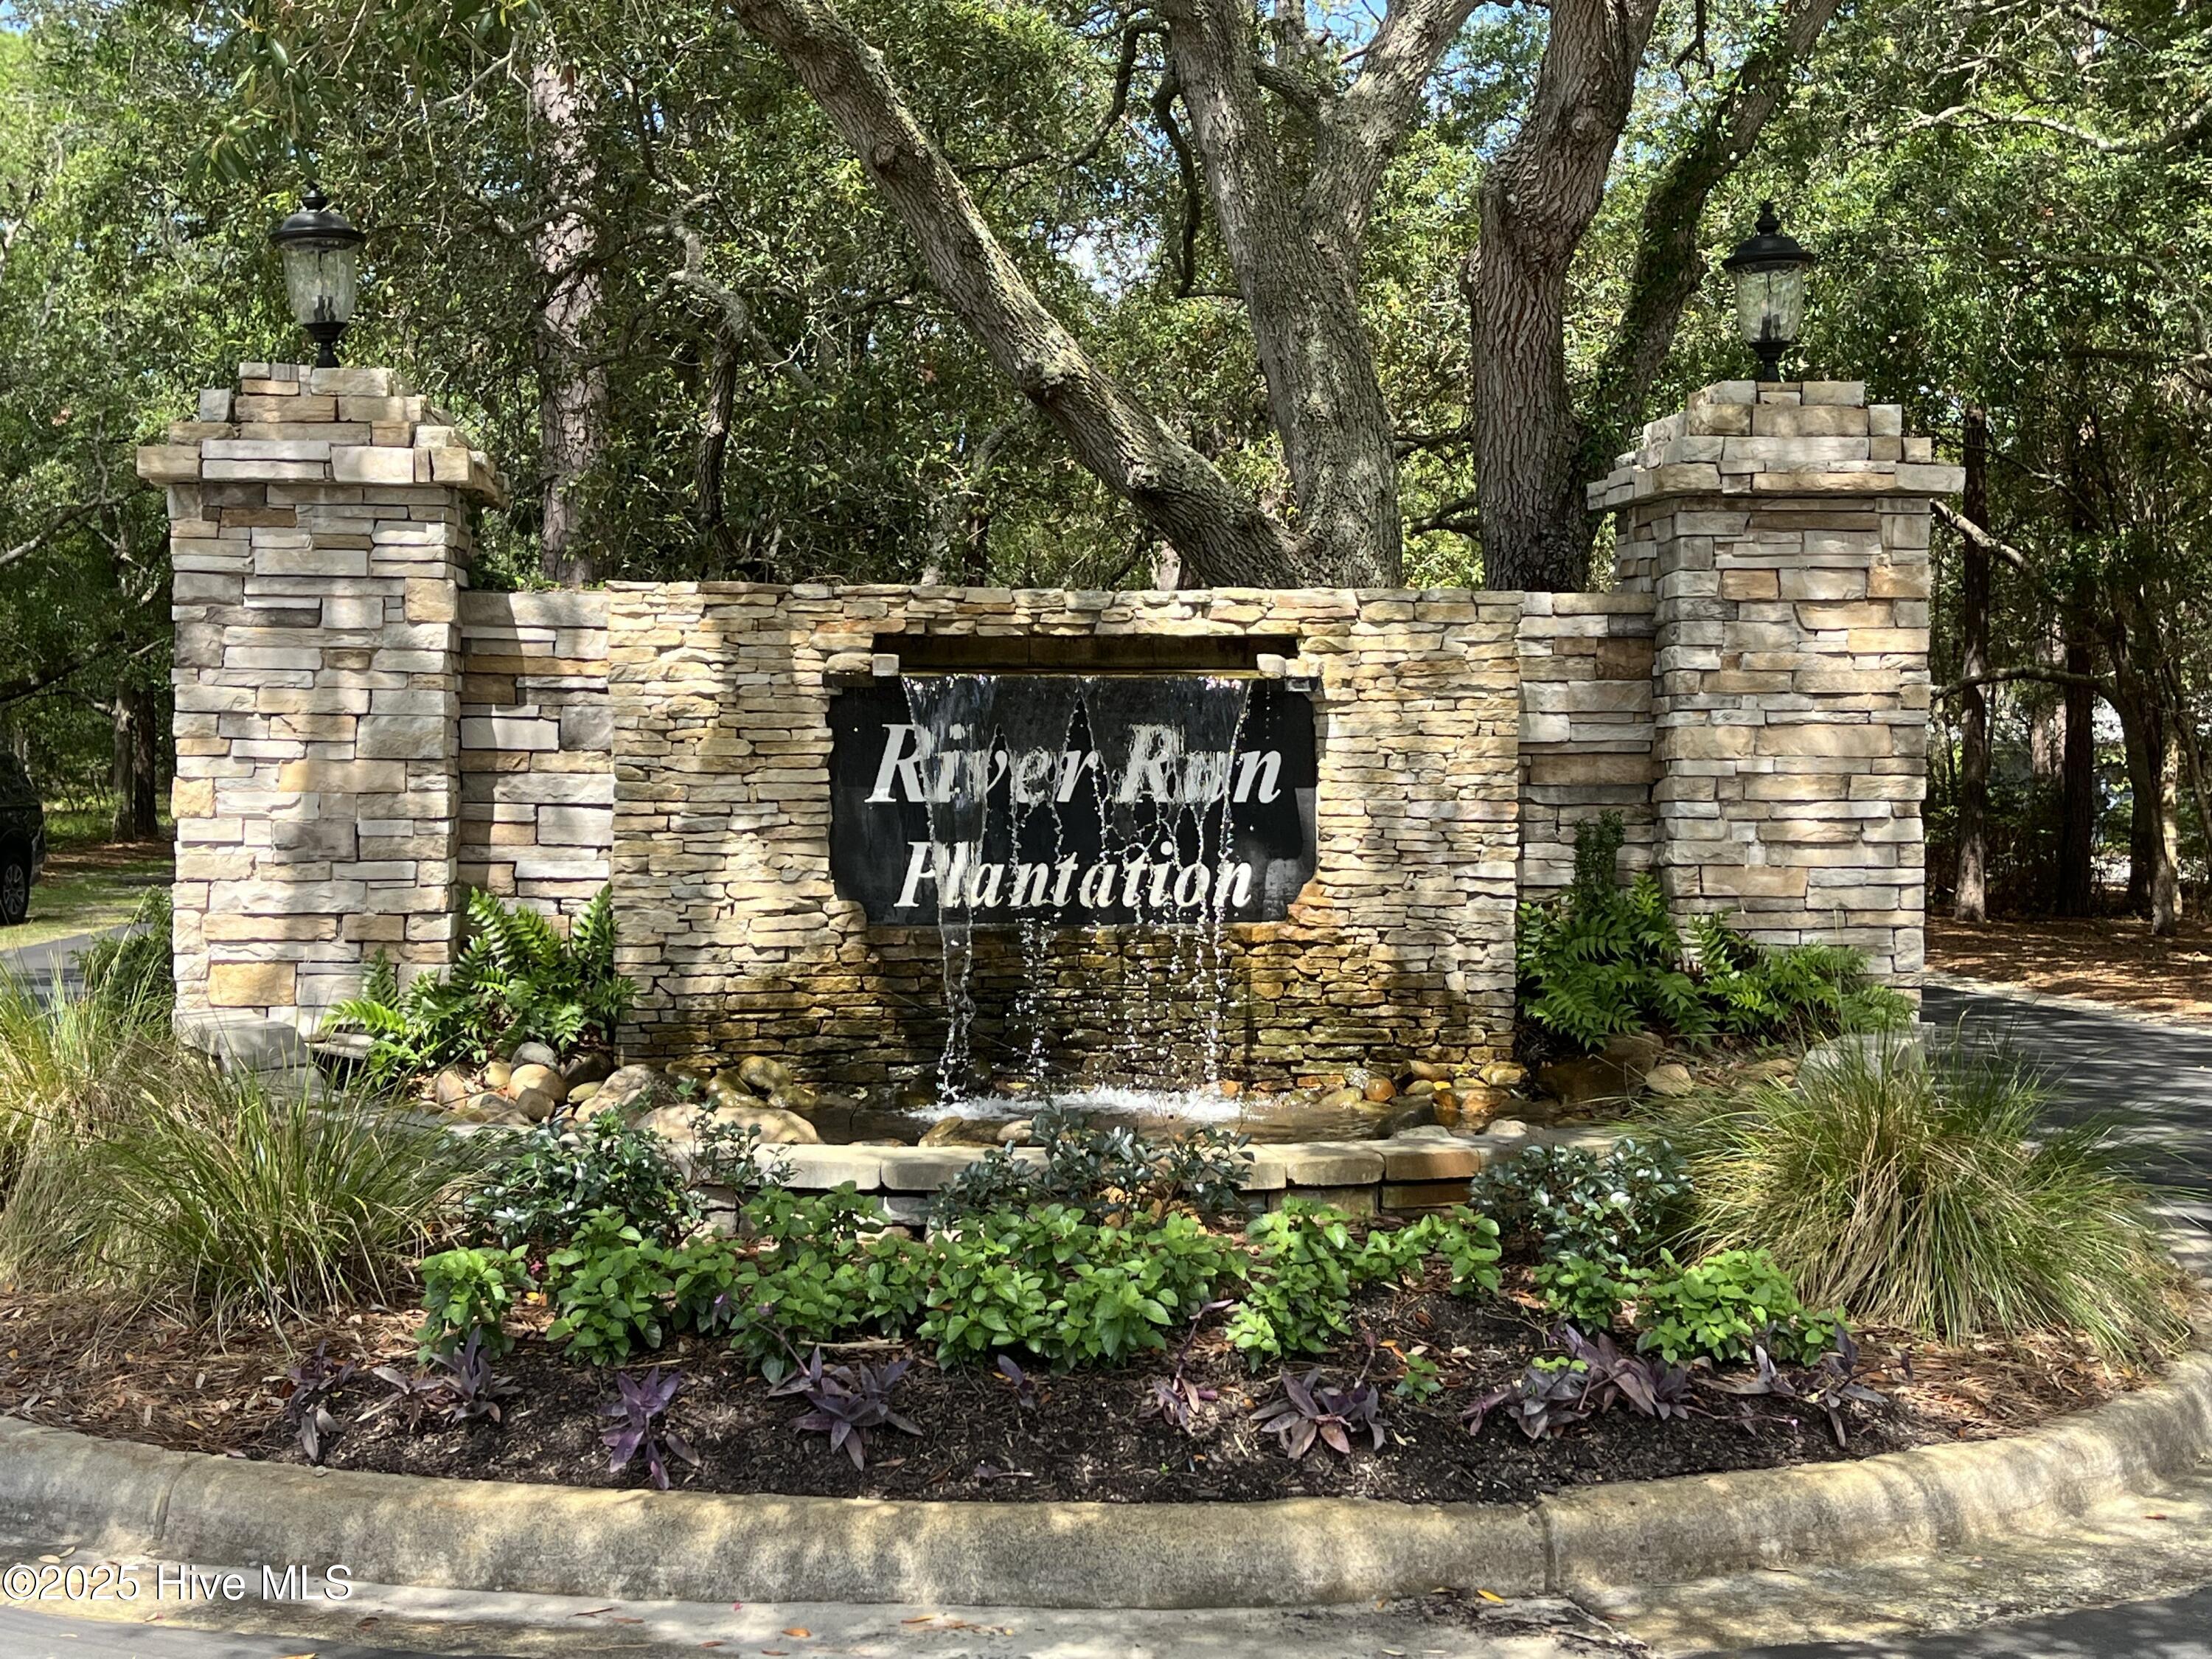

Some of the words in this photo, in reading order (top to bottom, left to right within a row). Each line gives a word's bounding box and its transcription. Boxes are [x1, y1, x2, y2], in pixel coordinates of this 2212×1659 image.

[864, 723, 1099, 804] River
[1114, 723, 1281, 804] Run
[893, 841, 1253, 908] Plantation
